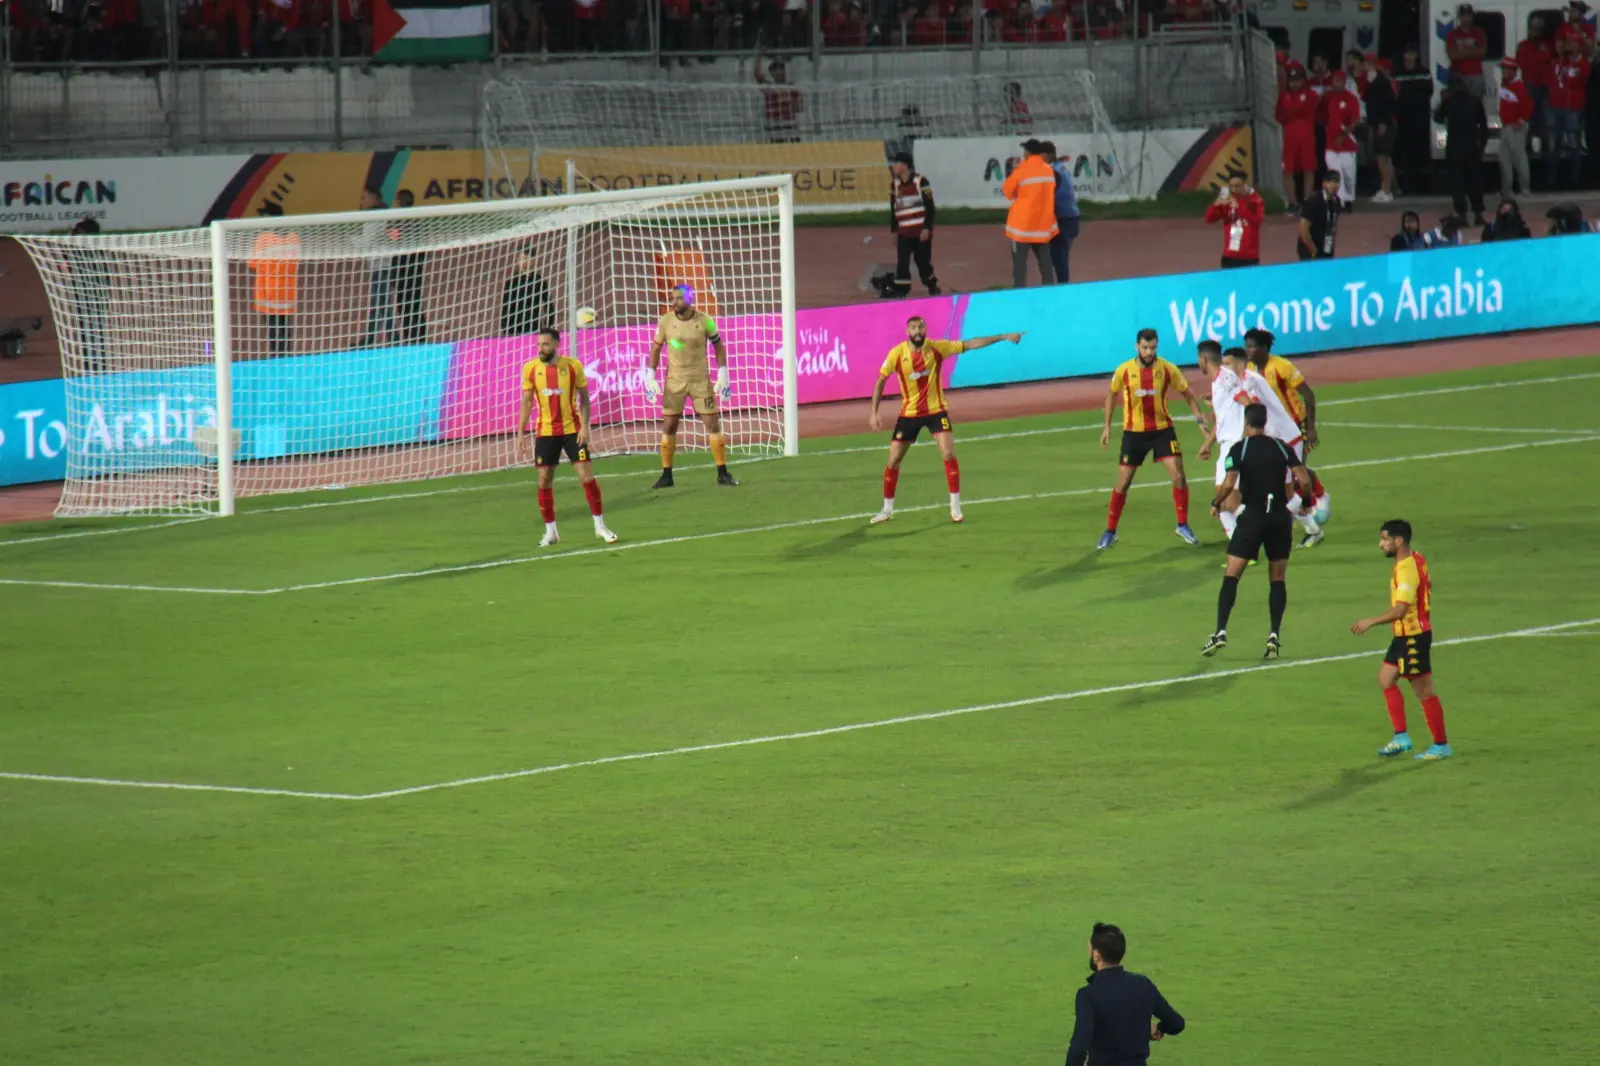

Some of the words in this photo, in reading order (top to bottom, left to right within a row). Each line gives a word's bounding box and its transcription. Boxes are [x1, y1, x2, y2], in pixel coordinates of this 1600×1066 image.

[424, 174, 564, 200] AFRICAN
[1168, 289, 1336, 347] Welcome
[1344, 281, 1384, 328] To
[1394, 266, 1503, 323] Arabia
[800, 326, 829, 345] Visit
[583, 354, 653, 402] Saud
[15, 408, 67, 460] To
